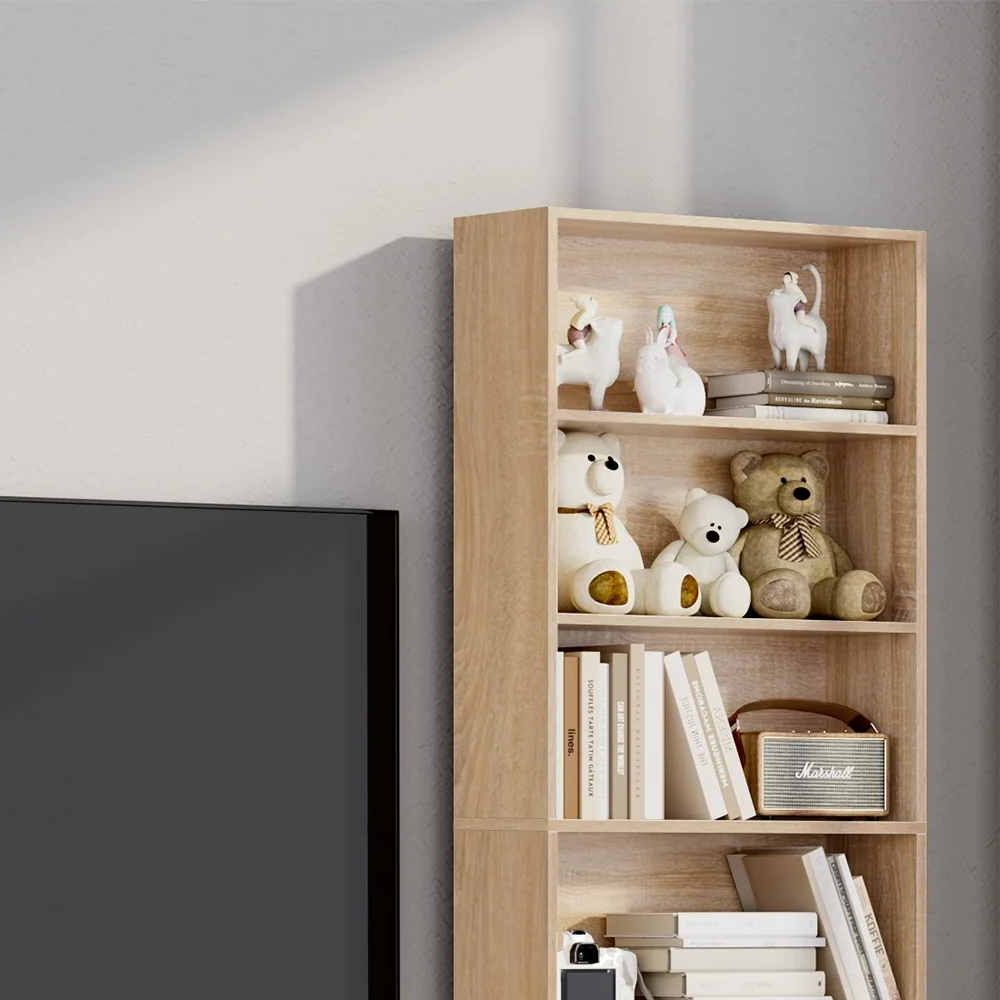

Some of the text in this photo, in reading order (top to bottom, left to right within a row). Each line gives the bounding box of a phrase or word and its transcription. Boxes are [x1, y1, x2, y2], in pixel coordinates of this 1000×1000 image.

[567, 729, 575, 756] lines.
[796, 762, 854, 779] Marshall
[864, 913, 884, 957] KOFFIE
